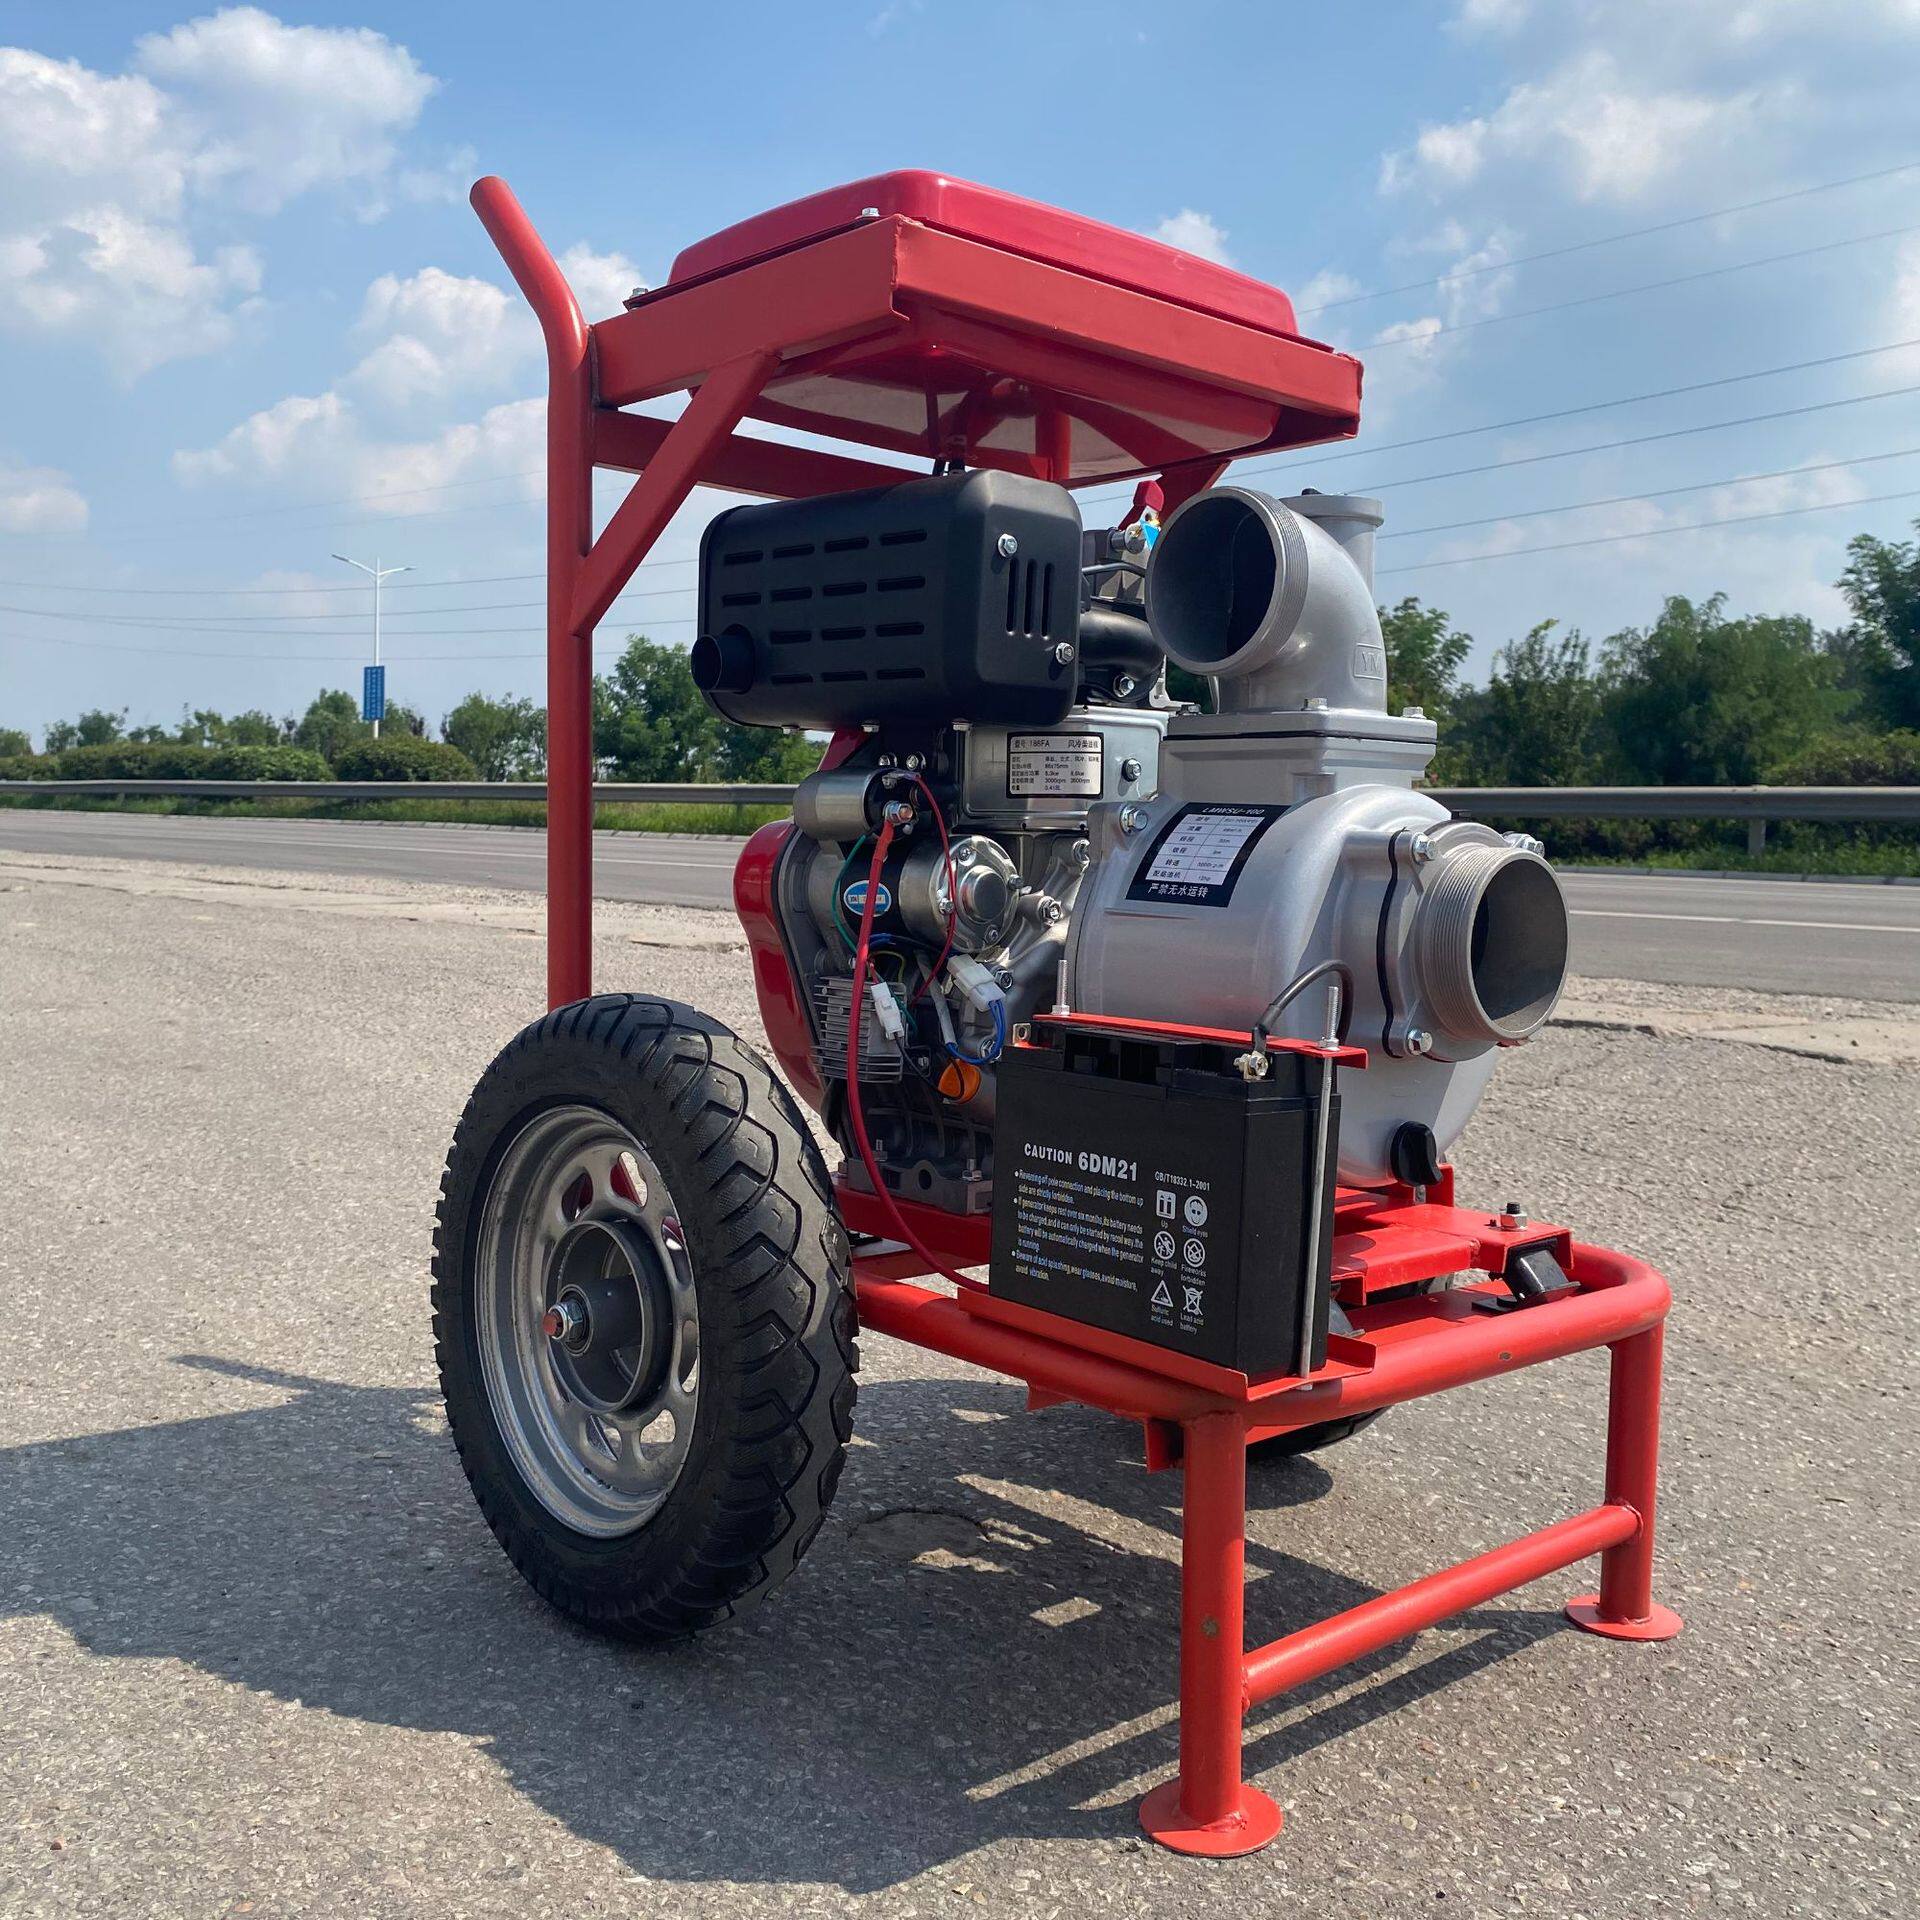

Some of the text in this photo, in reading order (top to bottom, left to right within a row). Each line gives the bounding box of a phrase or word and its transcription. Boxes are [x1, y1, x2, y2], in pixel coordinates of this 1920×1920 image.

[1148, 882, 1209, 898] 严禁无水运转
[1024, 1142, 1138, 1182] CAUTION 6DM21
